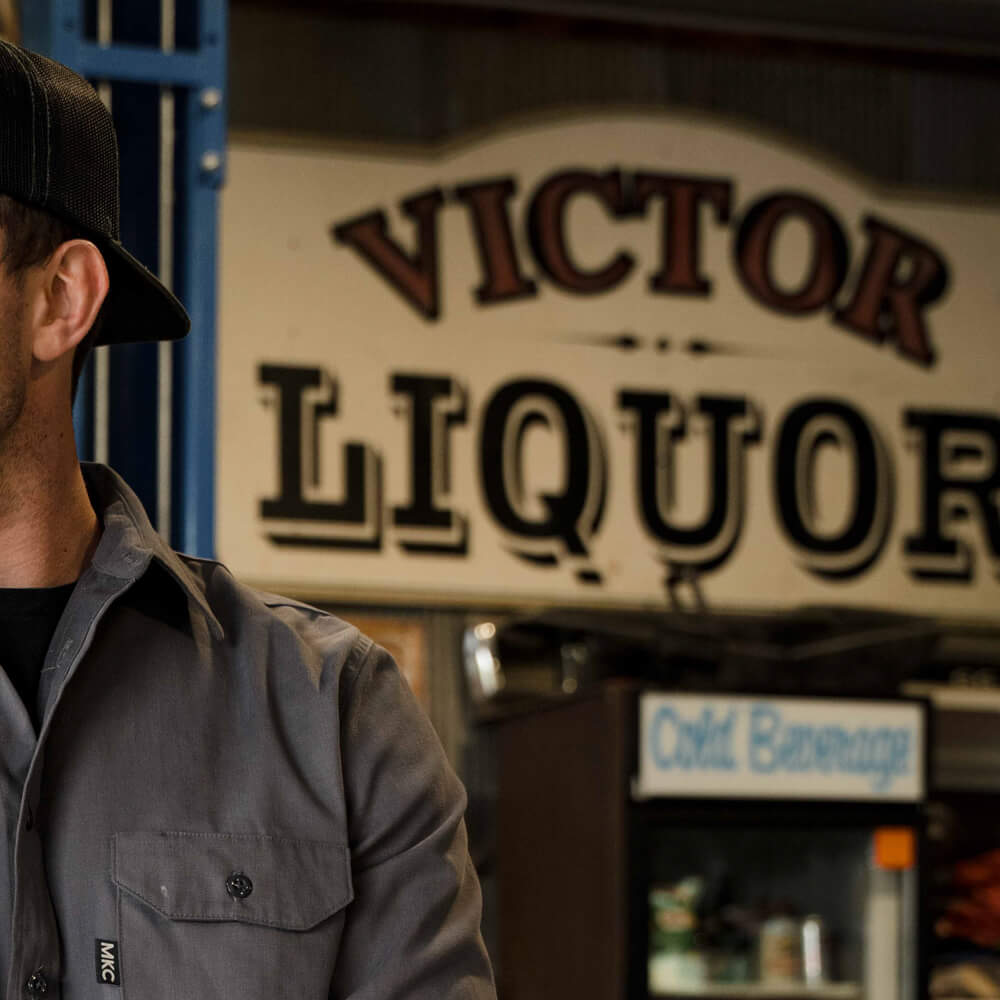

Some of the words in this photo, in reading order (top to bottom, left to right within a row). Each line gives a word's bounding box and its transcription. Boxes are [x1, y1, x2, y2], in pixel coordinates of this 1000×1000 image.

[331, 164, 955, 371] VICTOR
[258, 362, 1000, 584] LIQUOR
[652, 704, 738, 771] Cold
[101, 942, 115, 982] MKC
